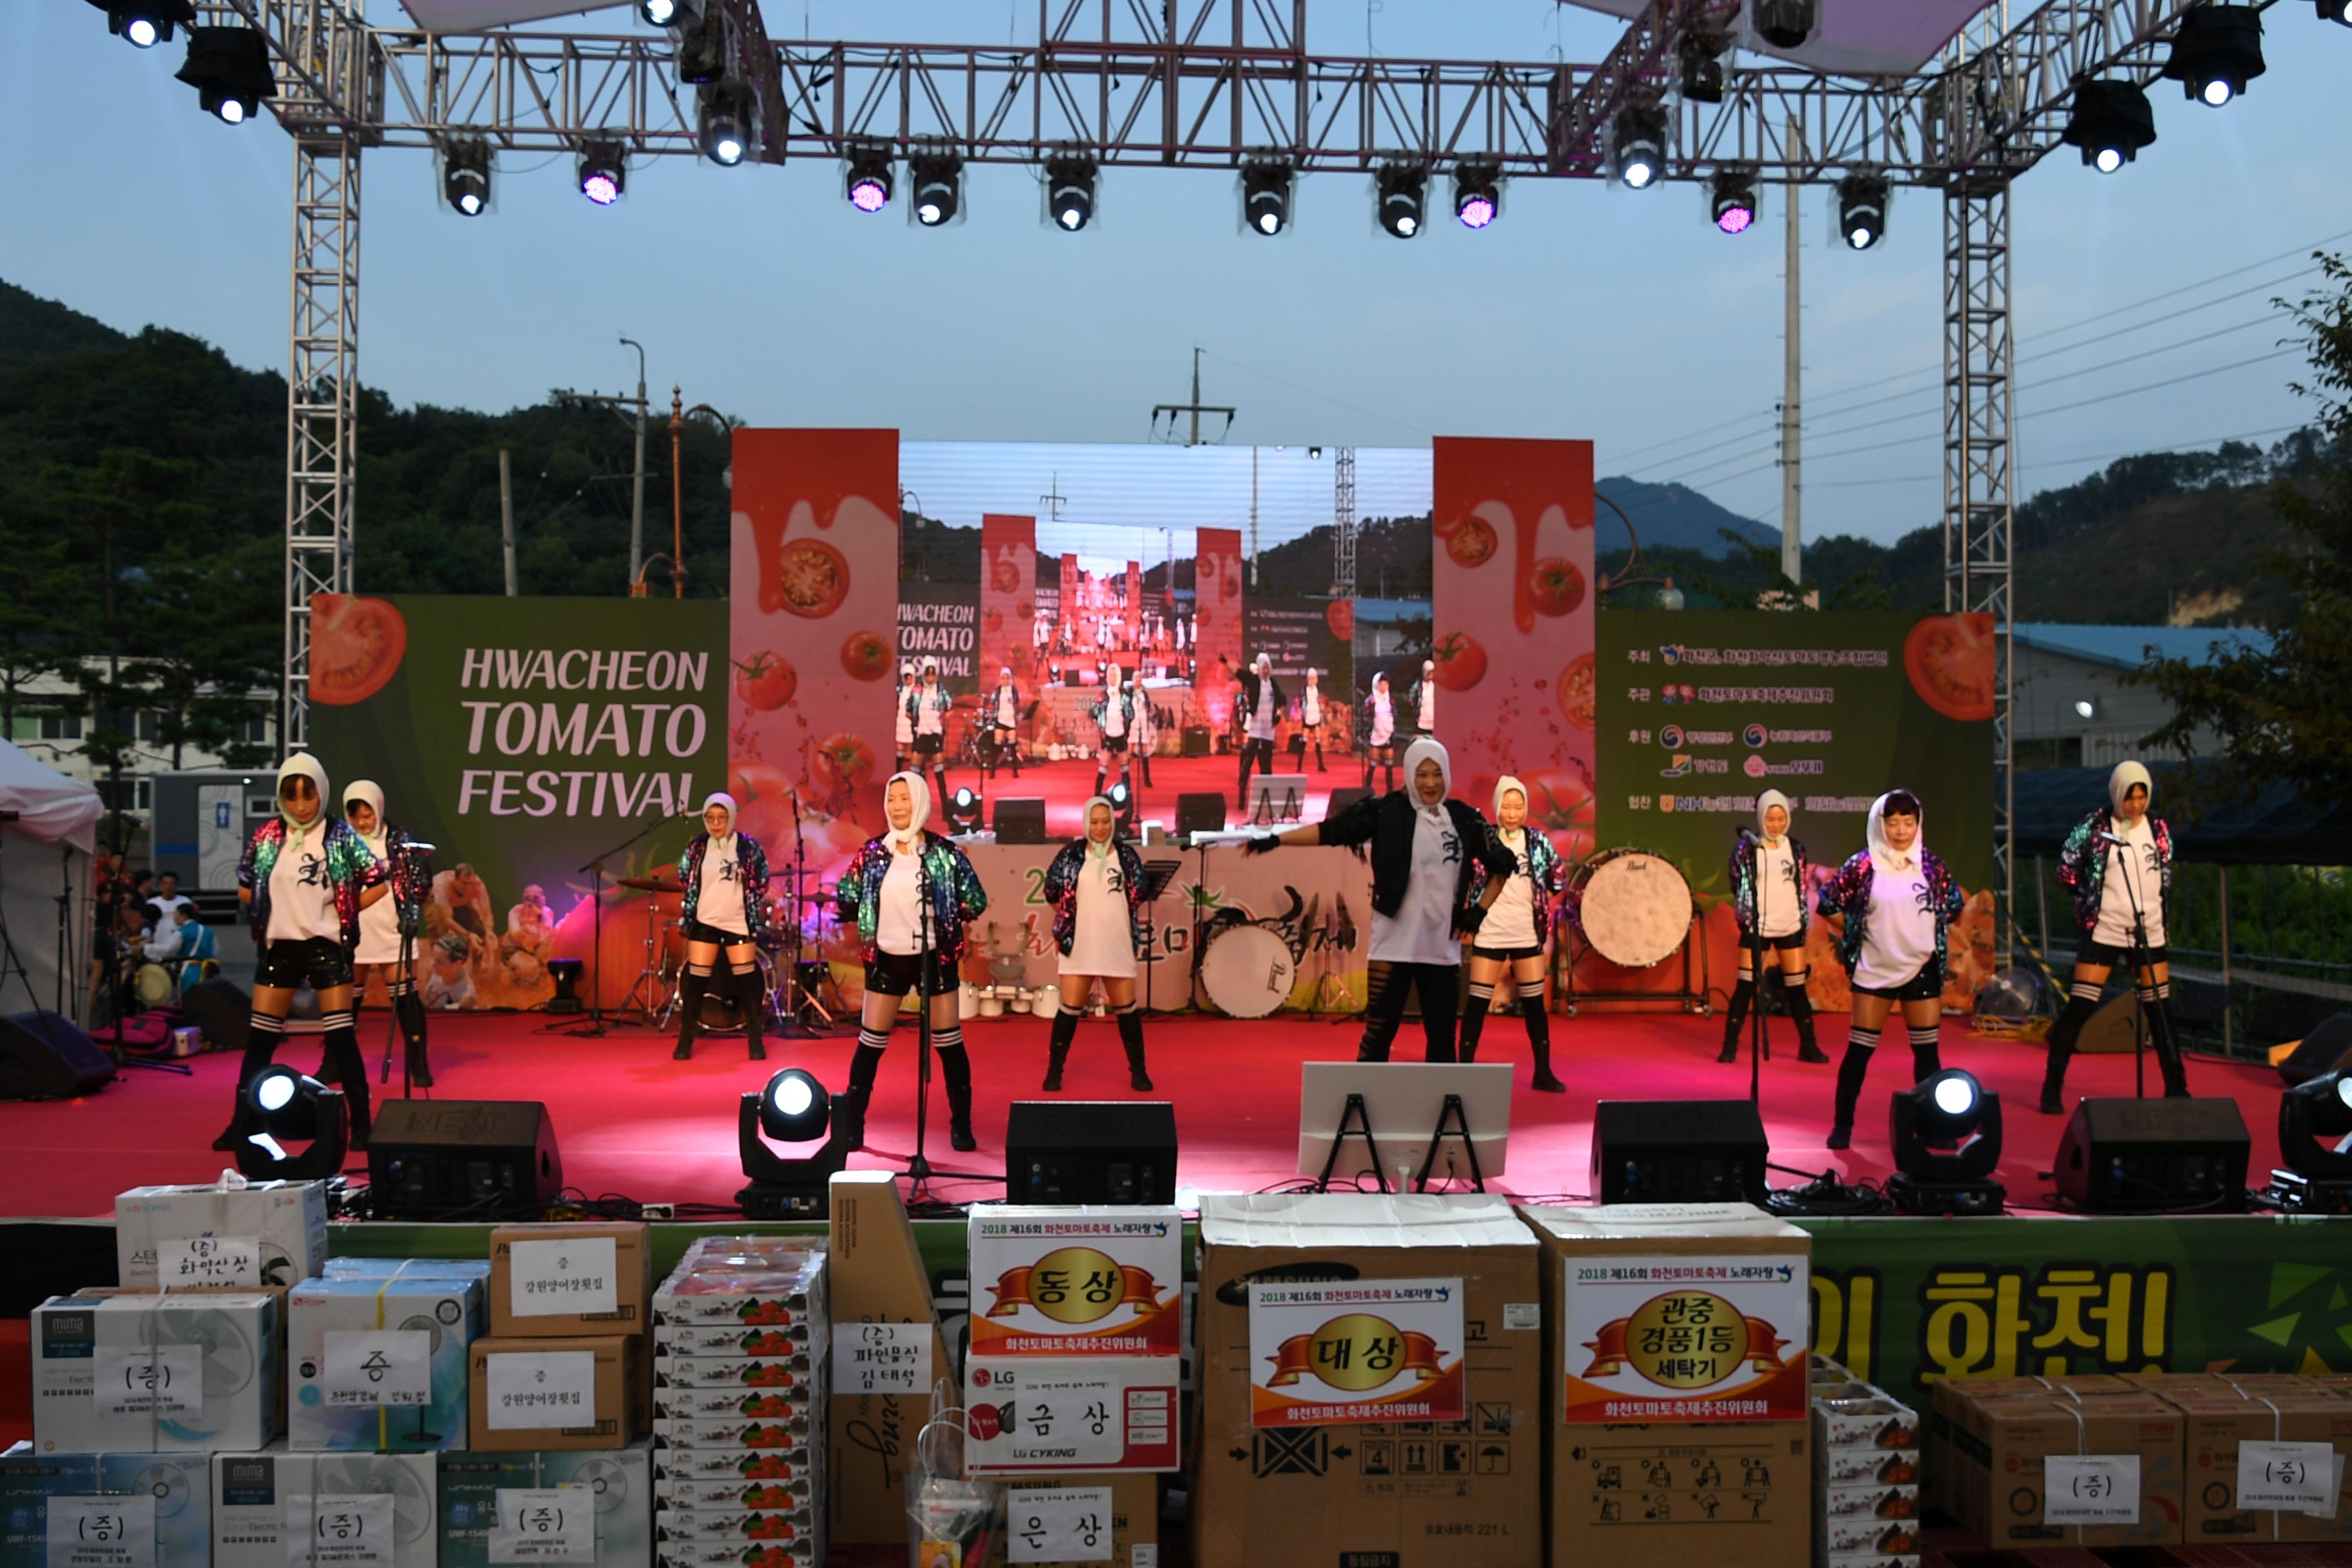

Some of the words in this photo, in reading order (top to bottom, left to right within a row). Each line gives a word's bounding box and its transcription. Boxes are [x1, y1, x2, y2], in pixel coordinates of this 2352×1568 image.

[460, 648, 709, 691] HWACHEON
[461, 701, 707, 758] TOMATO
[458, 769, 704, 818] FESTIVAL
[981, 1224, 1007, 1234] 2018
[1010, 1224, 1042, 1234] 제16회
[1044, 1224, 1110, 1235] 화천토마토축제
[1113, 1223, 1151, 1234] 노래자랑
[1578, 1268, 1607, 1279] 2018
[1611, 1268, 1647, 1279] 제16회
[1651, 1267, 1727, 1279] 화천토마토축제
[1730, 1266, 1773, 1278] 노래자랑
[525, 1277, 603, 1293] 강원양어장횟집
[1260, 1292, 1286, 1302] 2018
[1288, 1291, 1322, 1302] 제16회
[1324, 1289, 1391, 1300] 화천토마토축제
[1394, 1288, 1433, 1300] 노래자랑
[1660, 1297, 1714, 1324] 관중
[1005, 1337, 1148, 1351] 화천토마토축제추진위원회
[1639, 1326, 1735, 1353] 경품1등
[360, 1350, 392, 1382] 증
[1656, 1358, 1716, 1379] 세탁기
[994, 1371, 1014, 1384] LG
[502, 1391, 581, 1406] 강원양어장횟집
[1286, 1402, 1430, 1420] 화천토마토축제추진위원회
[1605, 1400, 1769, 1416] 화천토마토축제추진위원회
[1014, 1449, 1027, 1458] LG
[1030, 1448, 1077, 1458] CYKING
[1478, 1524, 1497, 1535] 221
[1502, 1524, 1509, 1535] L
